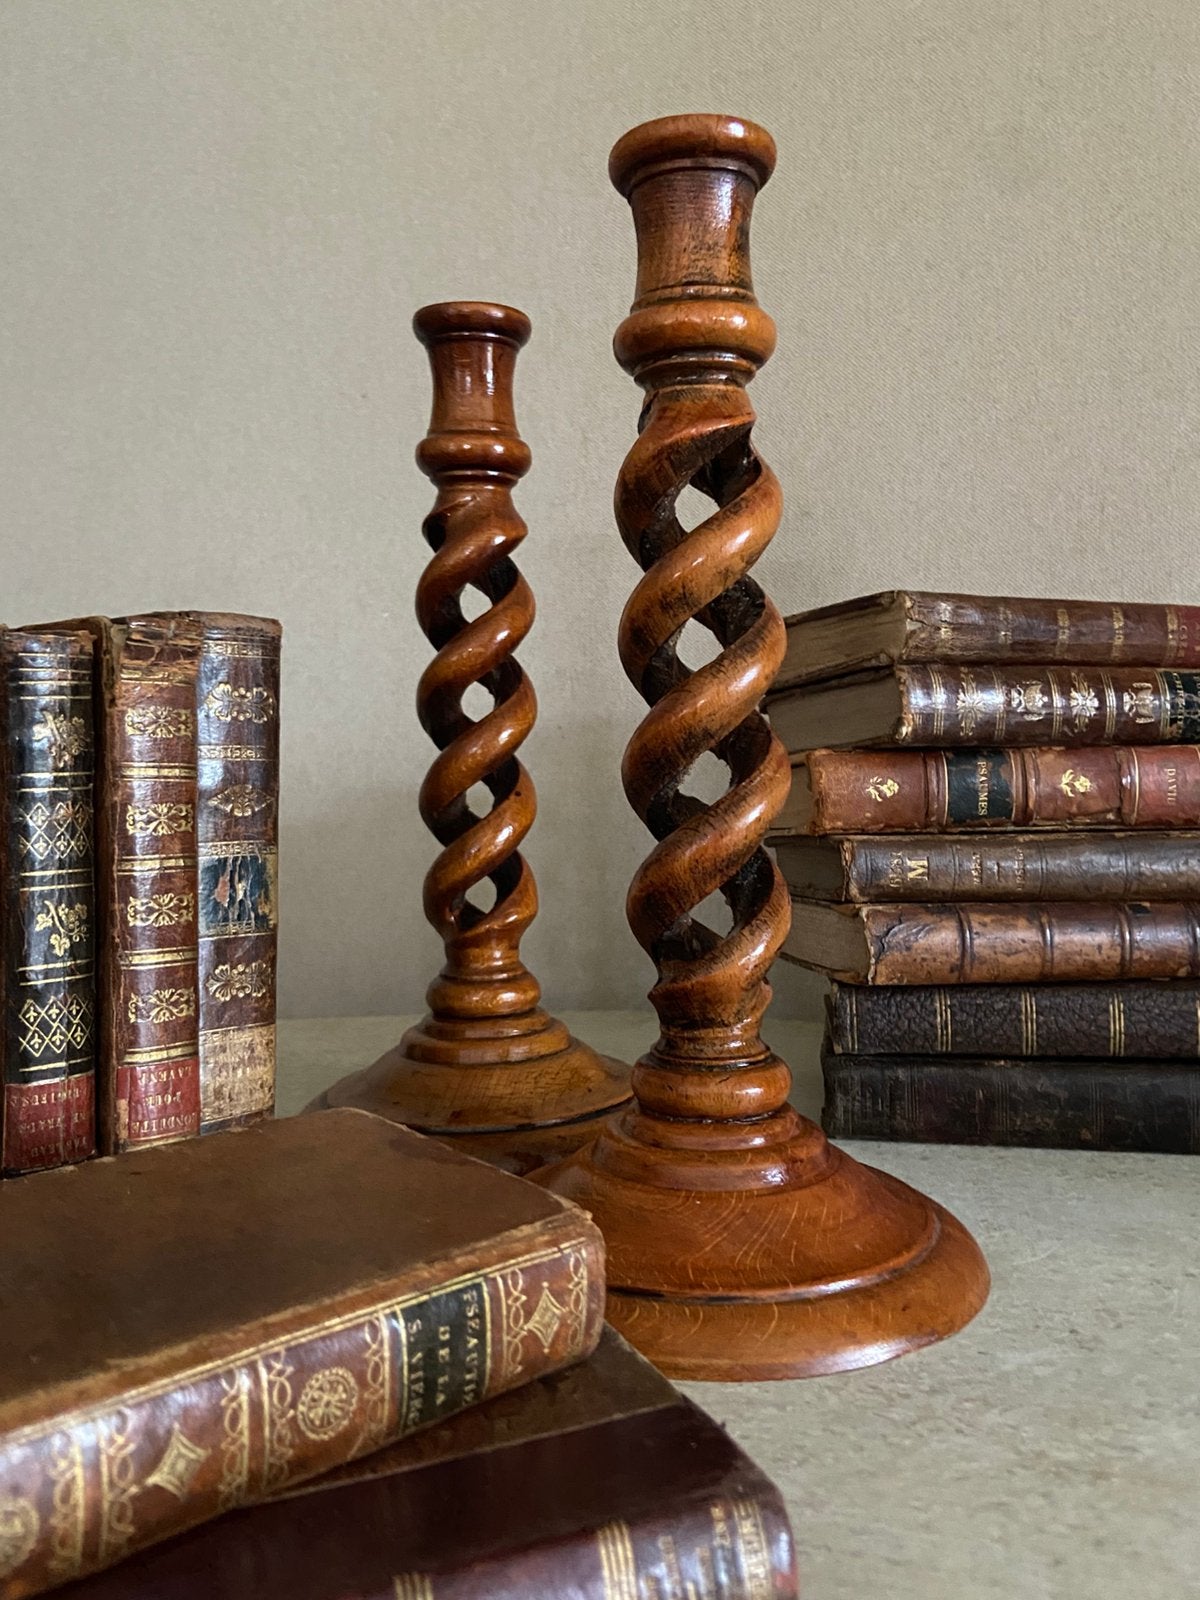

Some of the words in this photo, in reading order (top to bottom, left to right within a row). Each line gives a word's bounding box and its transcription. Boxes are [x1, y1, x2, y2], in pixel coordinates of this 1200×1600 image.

[977, 761, 989, 816] PSAUMES
[144, 1091, 182, 1107] POUR
[437, 1325, 451, 1364] DE
[435, 1374, 450, 1407] LA
